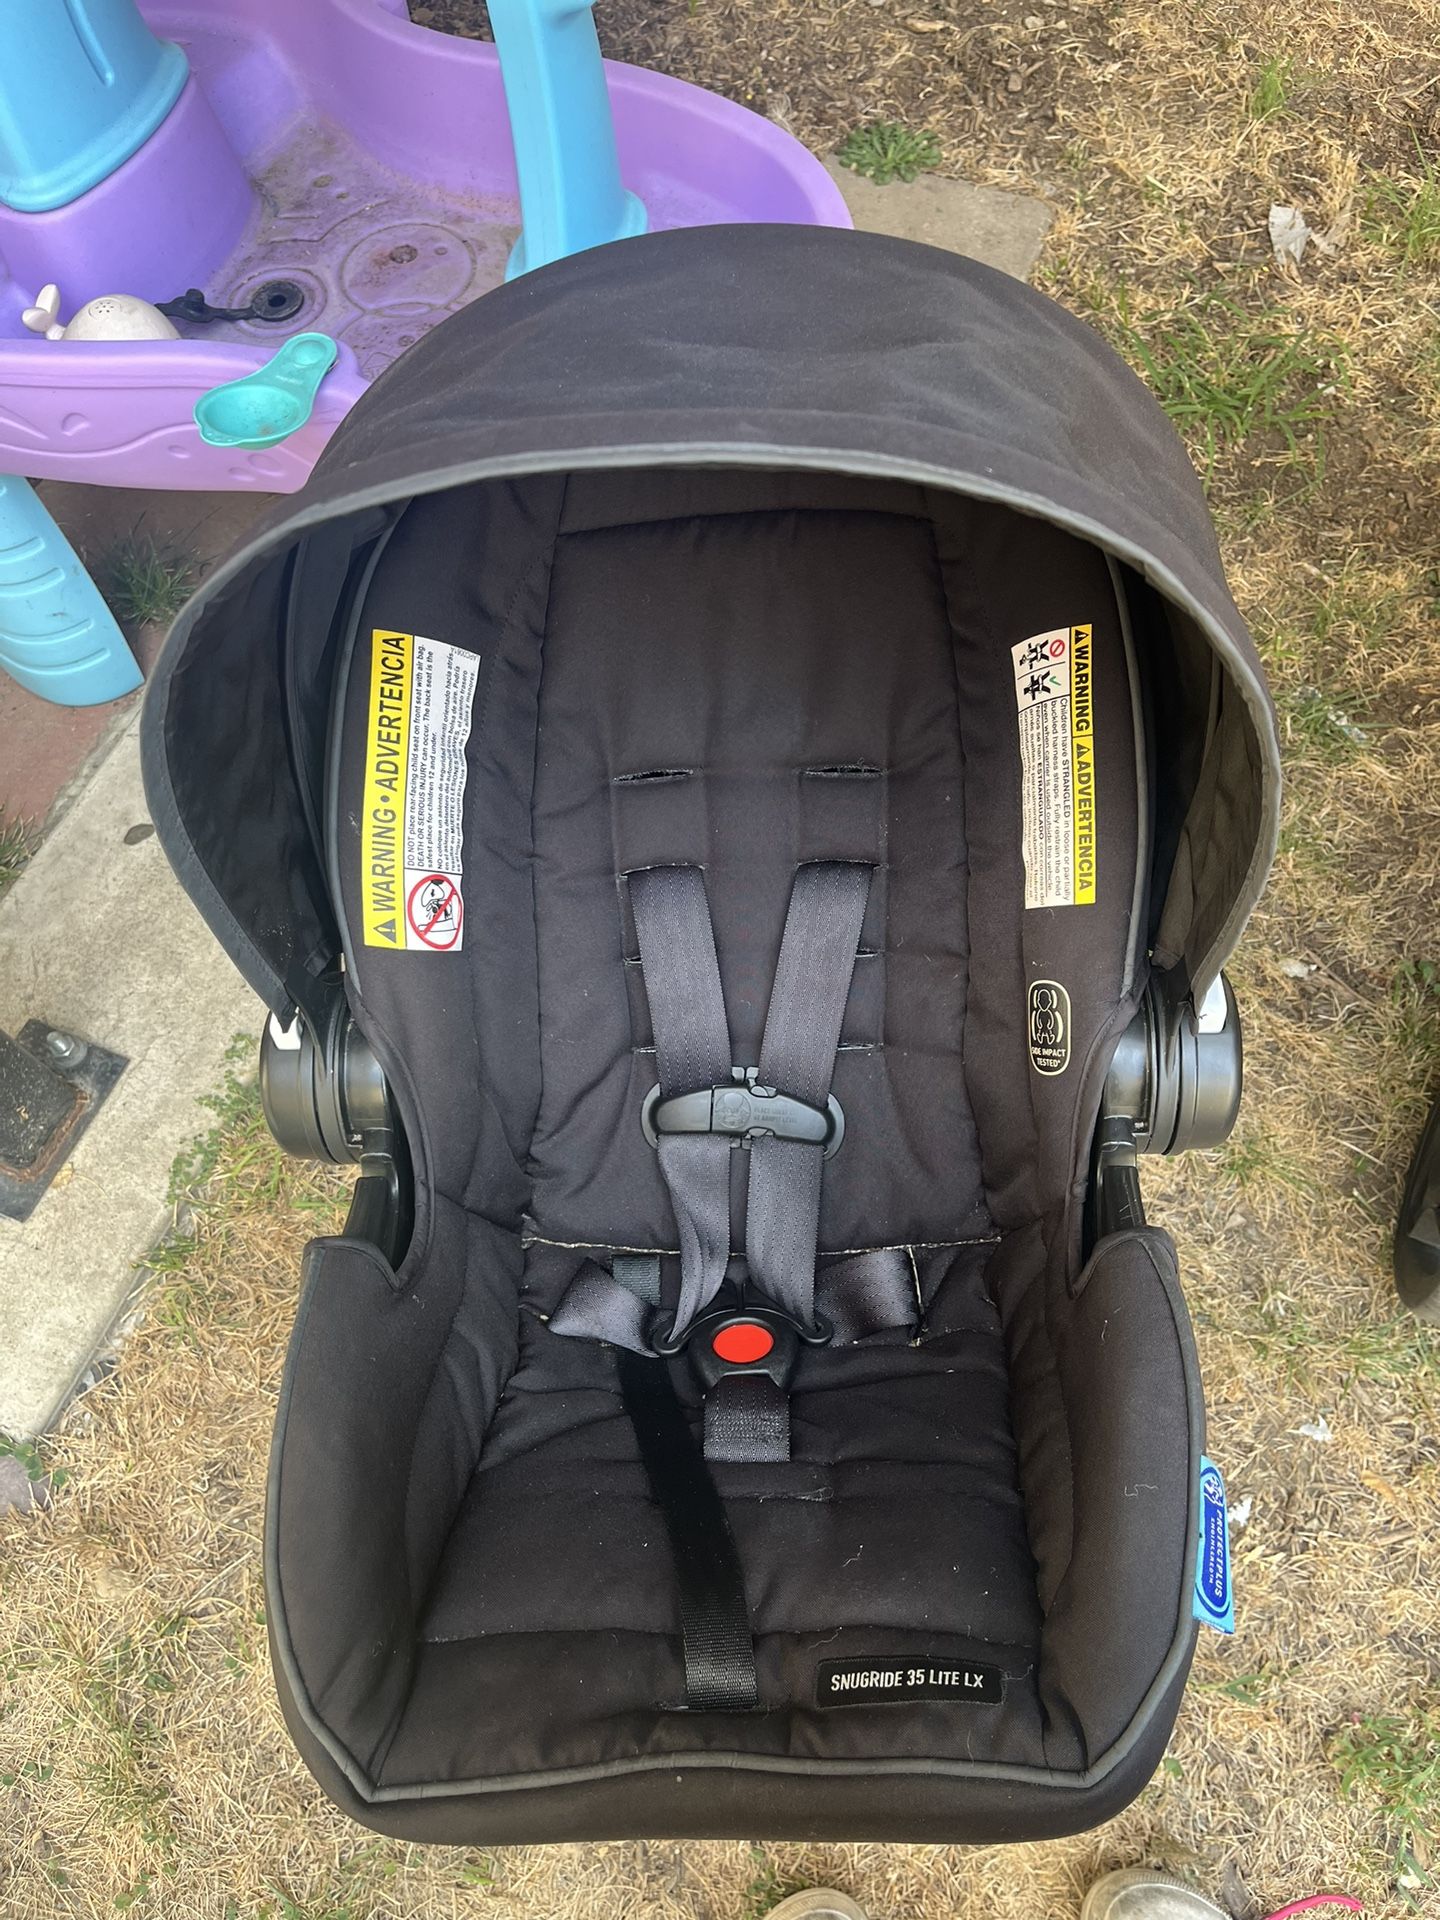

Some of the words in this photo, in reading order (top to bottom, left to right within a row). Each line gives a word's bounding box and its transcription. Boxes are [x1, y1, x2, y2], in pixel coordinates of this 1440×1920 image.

[417, 645, 425, 659] bag.
[1074, 645, 1090, 731] WARNING
[374, 636, 405, 792] ADVERTENCIA
[414, 725, 420, 734] on
[450, 761, 459, 795] LESIONES
[459, 670, 467, 694] trasero
[429, 771, 434, 779] 12
[408, 774, 418, 813] rear-facing
[438, 783, 443, 791] de
[445, 862, 449, 870] en
[451, 706, 457, 714] de
[438, 820, 442, 828] un
[1077, 761, 1092, 890] ADVERTENCIA
[418, 828, 424, 839] OR
[372, 808, 396, 912] WARNING
[408, 855, 414, 866] DO
[437, 859, 443, 869] NO
[1064, 857, 1070, 865] or
[1042, 1048, 1066, 1057] IMPACT
[1214, 1510, 1223, 1598] PROTECTPLUS
[831, 1670, 903, 1691] SNUGRIDE
[907, 1669, 925, 1686] 35
[929, 1669, 960, 1685] LITE
[964, 1673, 983, 1688] LX
